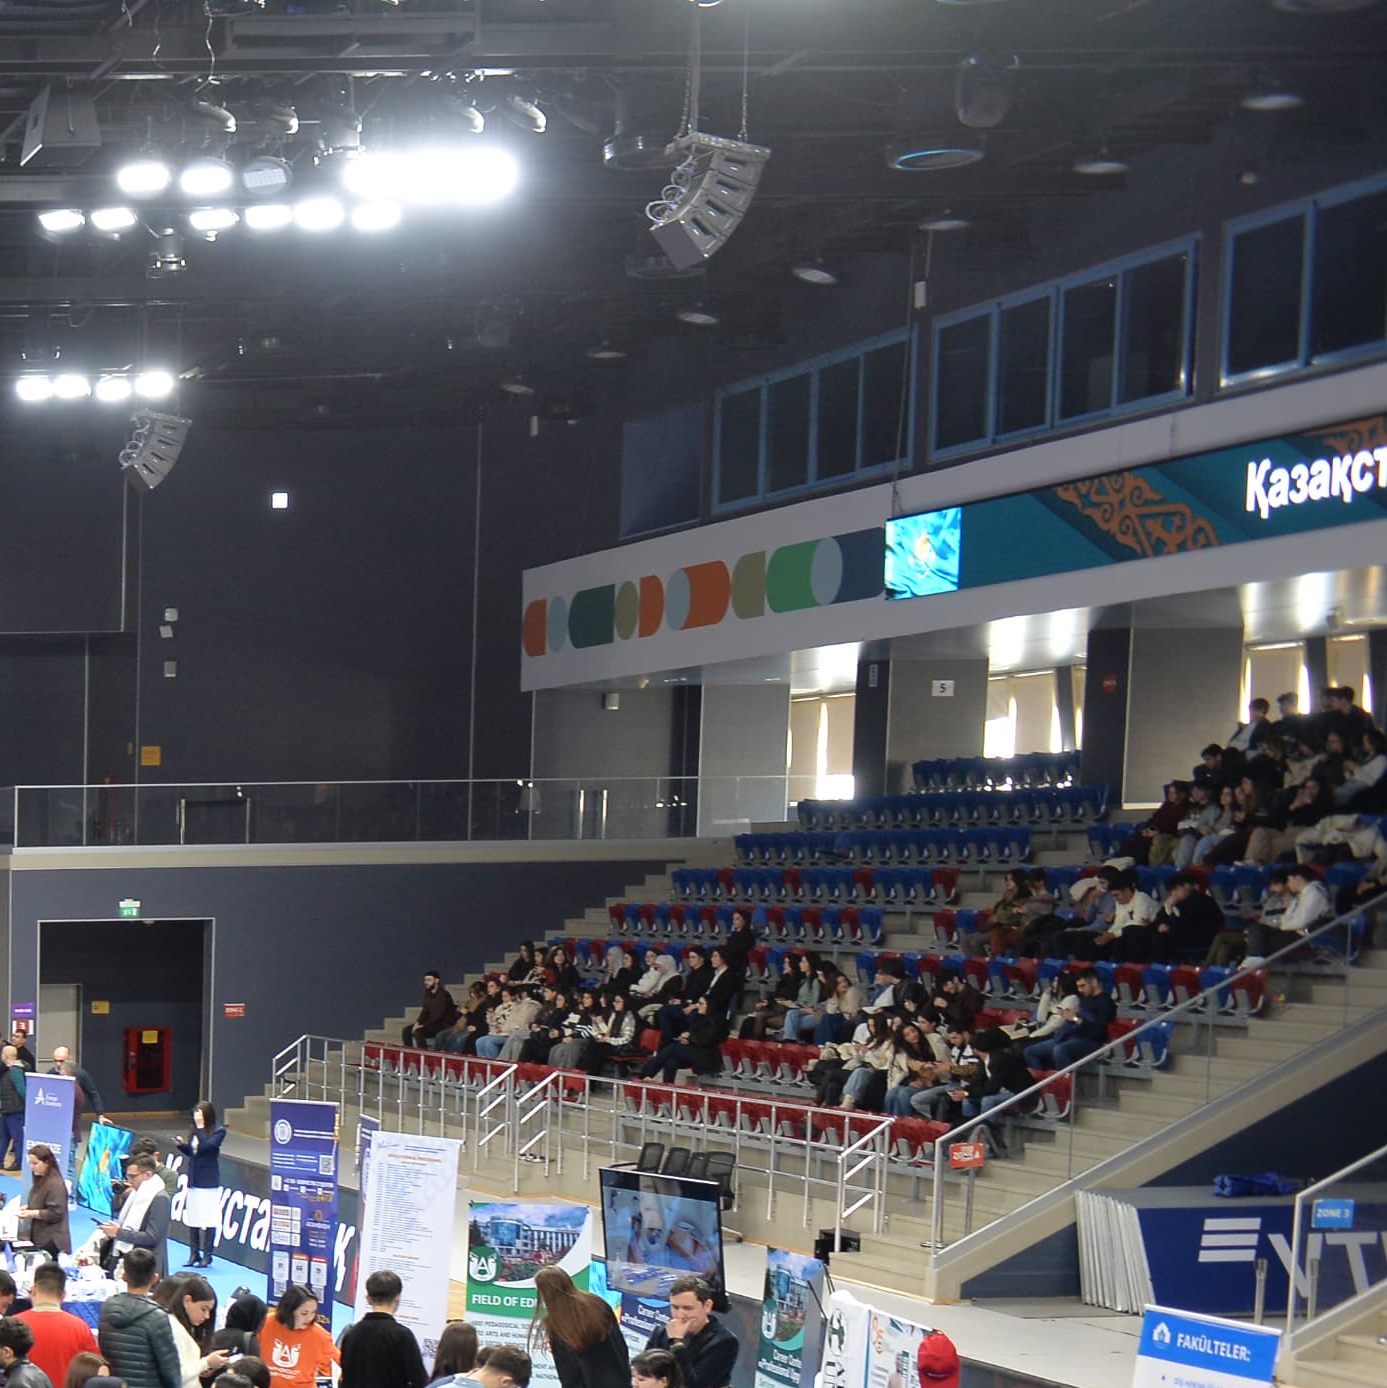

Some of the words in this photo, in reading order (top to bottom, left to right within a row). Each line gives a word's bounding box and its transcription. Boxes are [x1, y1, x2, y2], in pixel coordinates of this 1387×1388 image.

[1316, 1208, 1341, 1219] ZONE
[472, 1294, 502, 1306] FIELD
[503, 1296, 519, 1307] OF
[1176, 1333, 1252, 1362] FAKÜLTELER:
